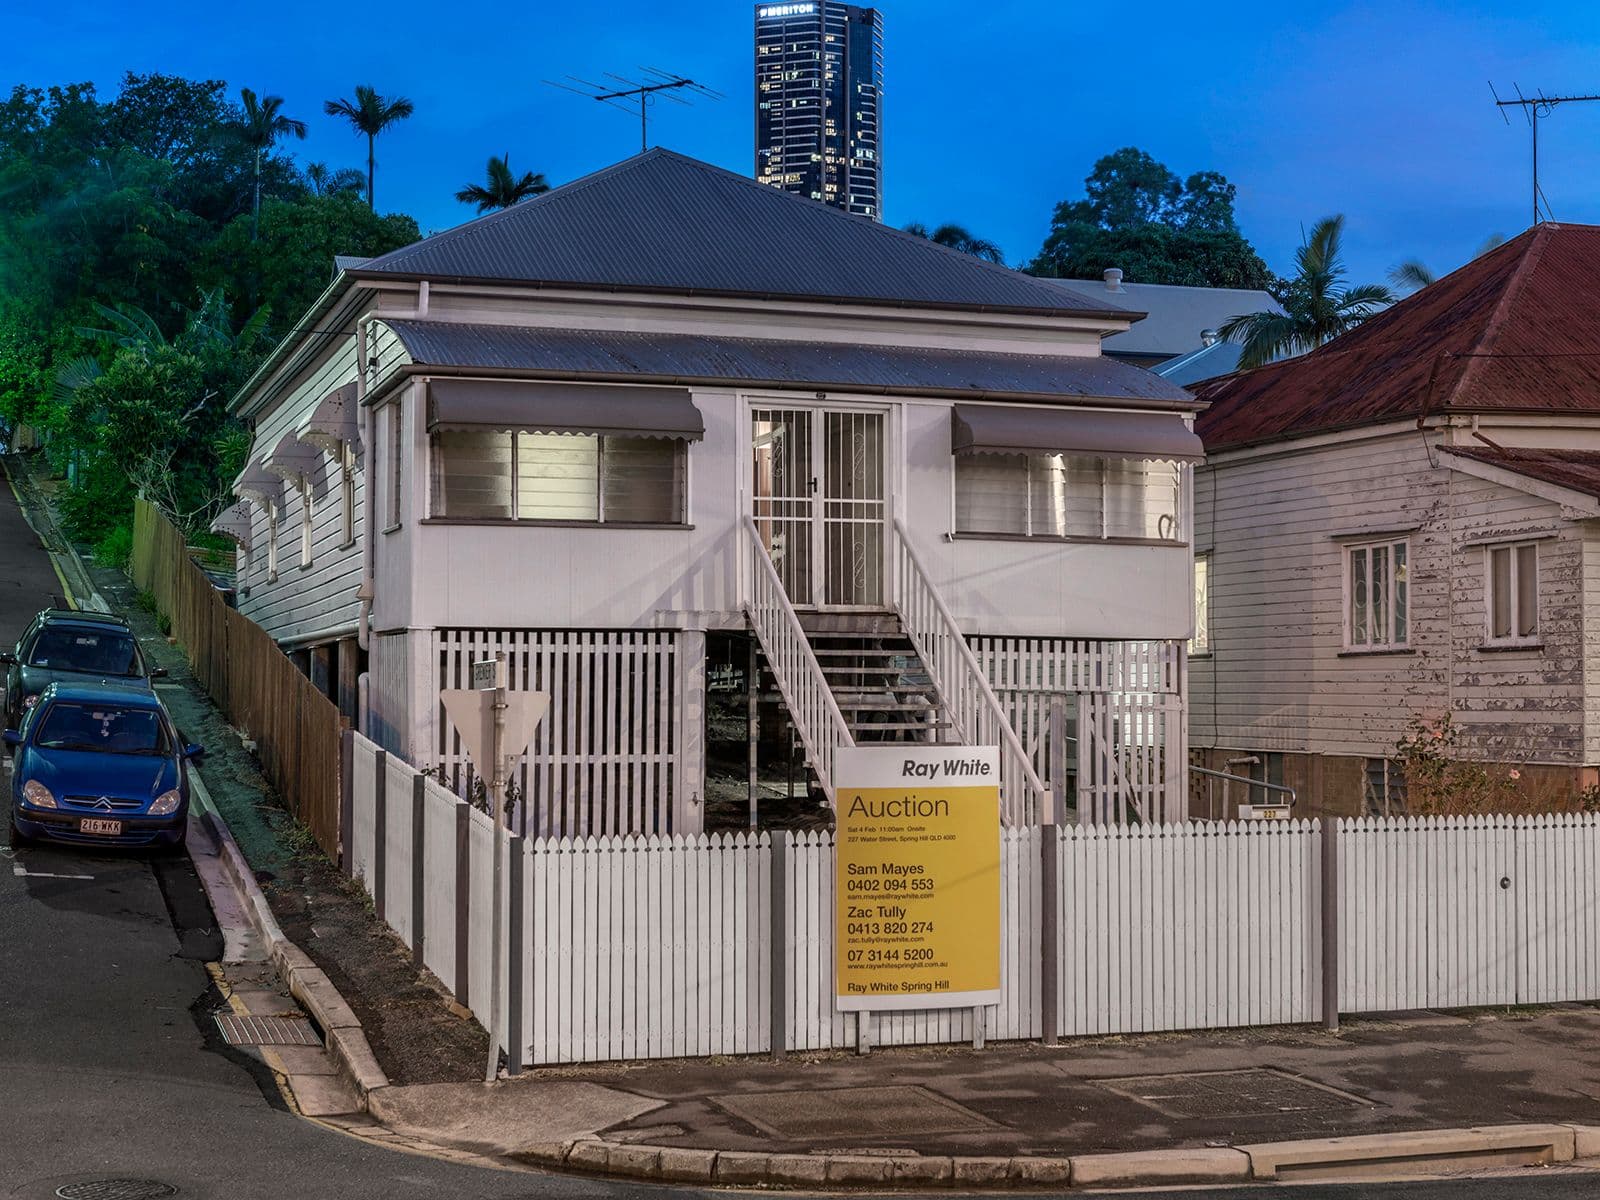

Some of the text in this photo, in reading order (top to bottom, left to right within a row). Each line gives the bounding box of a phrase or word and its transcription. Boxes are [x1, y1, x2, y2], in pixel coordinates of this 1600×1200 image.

[902, 759, 991, 780] Ray White
[848, 795, 949, 818] Auction
[899, 835, 918, 843] Spring
[929, 834, 942, 842] QLD
[848, 863, 924, 878] Sam Mayes
[848, 878, 934, 891] 0402 094 553
[848, 892, 934, 901] sam.mayes@raywhite.com
[848, 905, 907, 921] Zac Tully
[848, 922, 934, 935] 0413 820 274
[848, 935, 924, 944] zac.tully@raywhite.com
[848, 948, 934, 962] 07 3144 5200
[848, 961, 948, 970] www.raywhitespringhill.com.au
[848, 979, 950, 993] Ray White Spring Hill
